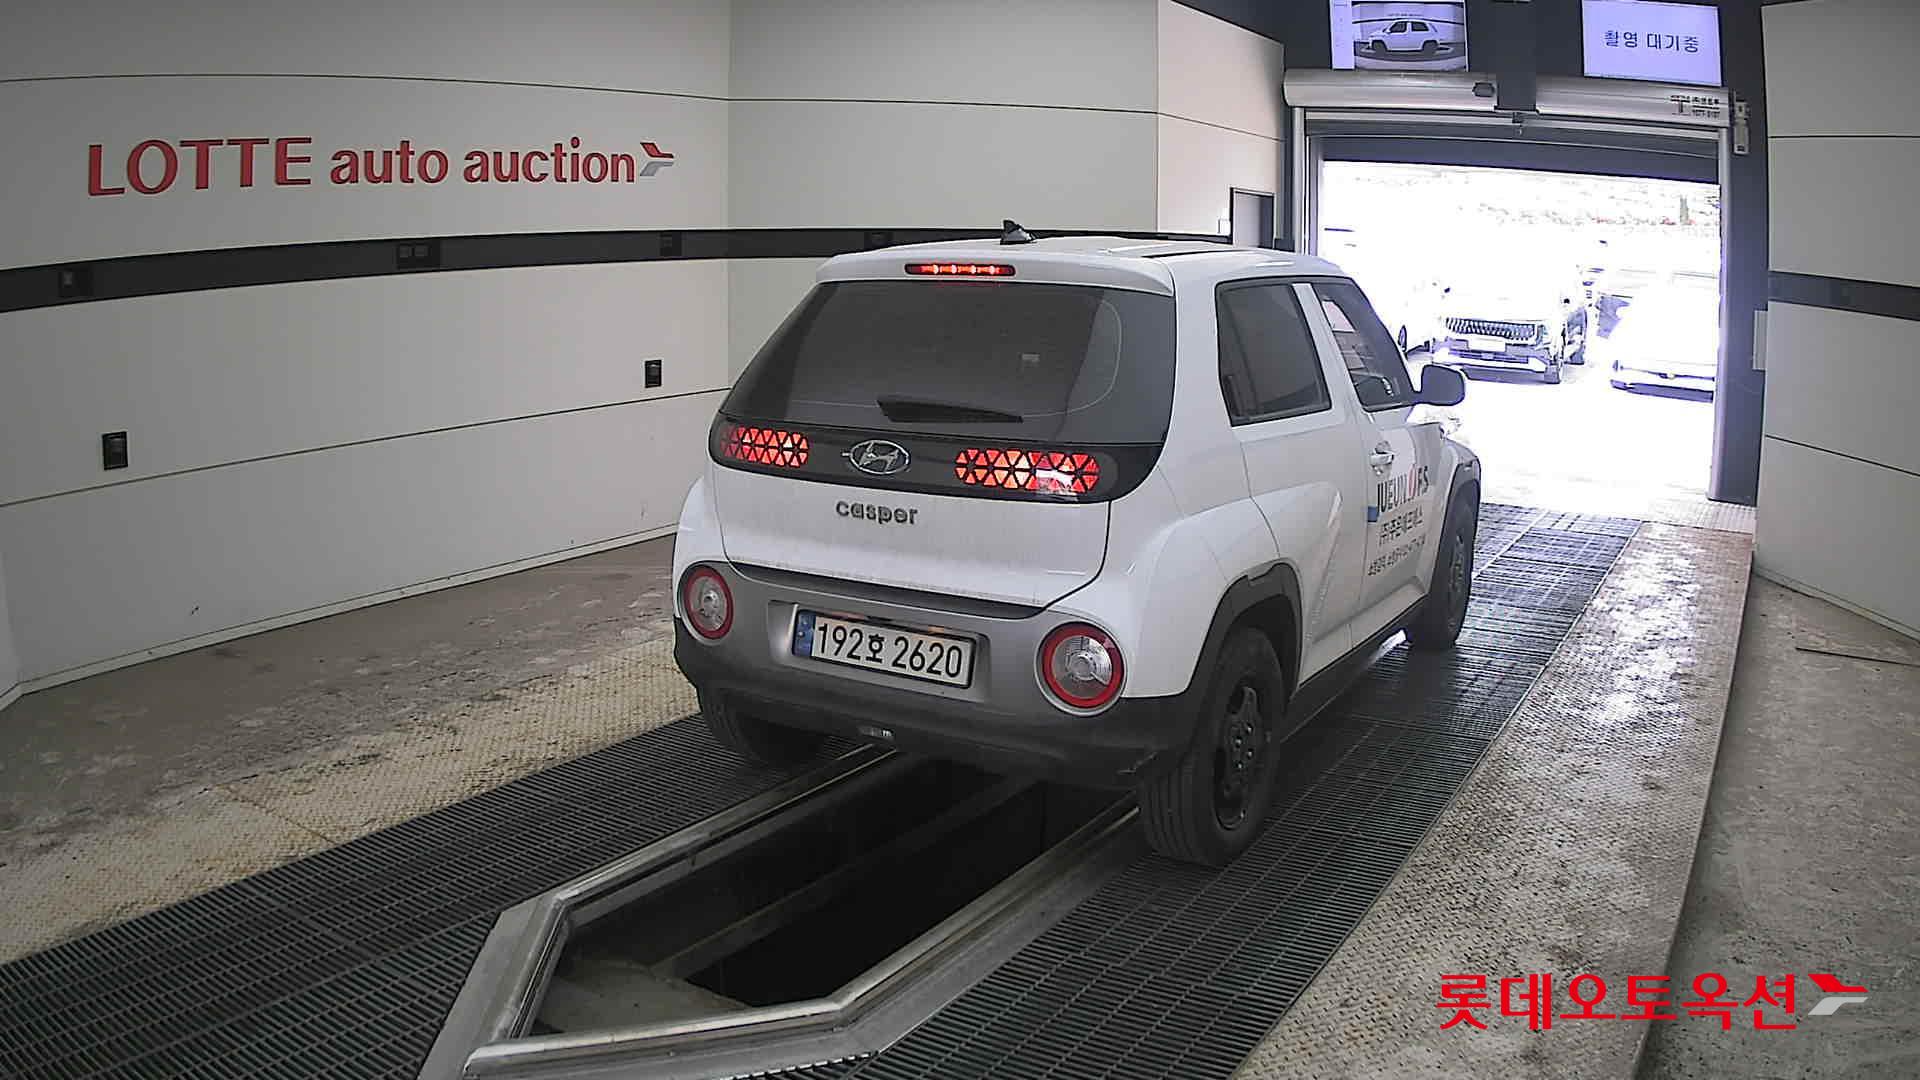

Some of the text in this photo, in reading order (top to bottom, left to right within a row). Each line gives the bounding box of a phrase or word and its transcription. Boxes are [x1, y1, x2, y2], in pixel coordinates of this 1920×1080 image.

[1604, 30, 1699, 53] 촬영 대기중
[88, 137, 636, 196] LOTTE auto auction
[835, 499, 919, 526] casper
[818, 622, 962, 678] 192호 2620
